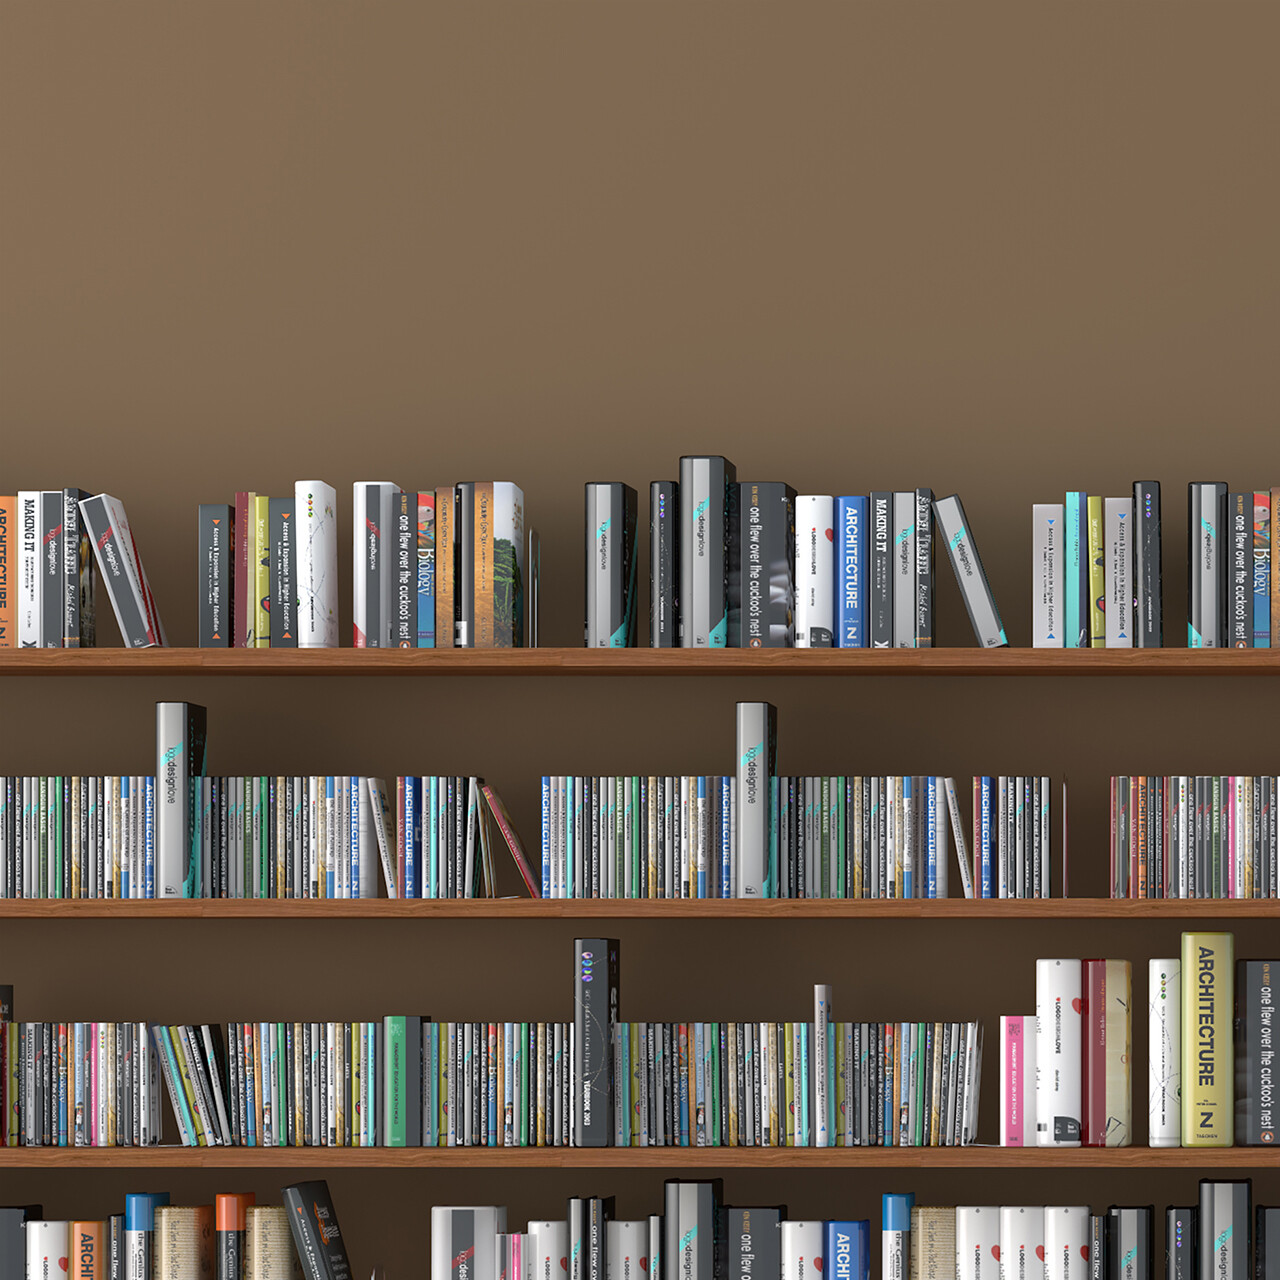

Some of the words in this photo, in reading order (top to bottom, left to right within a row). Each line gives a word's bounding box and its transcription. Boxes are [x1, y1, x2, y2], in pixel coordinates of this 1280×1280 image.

[24, 499, 35, 539] MAKING
[876, 499, 887, 540] MAKING
[1235, 515, 1244, 532] one
[24, 541, 35, 552] IT
[876, 542, 887, 552] IT
[1235, 532, 1247, 548] flew
[846, 507, 857, 608] ARCHITECTURE
[1235, 551, 1244, 568] over
[418, 548, 435, 597] Biology
[1235, 571, 1247, 583] the
[1254, 547, 1270, 597] Biology
[1235, 622, 1246, 638] nest
[1261, 987, 1270, 1006] one
[1199, 947, 1214, 1086] ARCHITECTURE
[1261, 1006, 1274, 1025] flew
[1261, 1027, 1270, 1048] over
[1261, 1051, 1274, 1065] the
[1261, 1110, 1273, 1129] nest
[741, 1234, 750, 1254] one
[228, 1248, 236, 1279] Genius
[741, 1254, 754, 1272] flew
